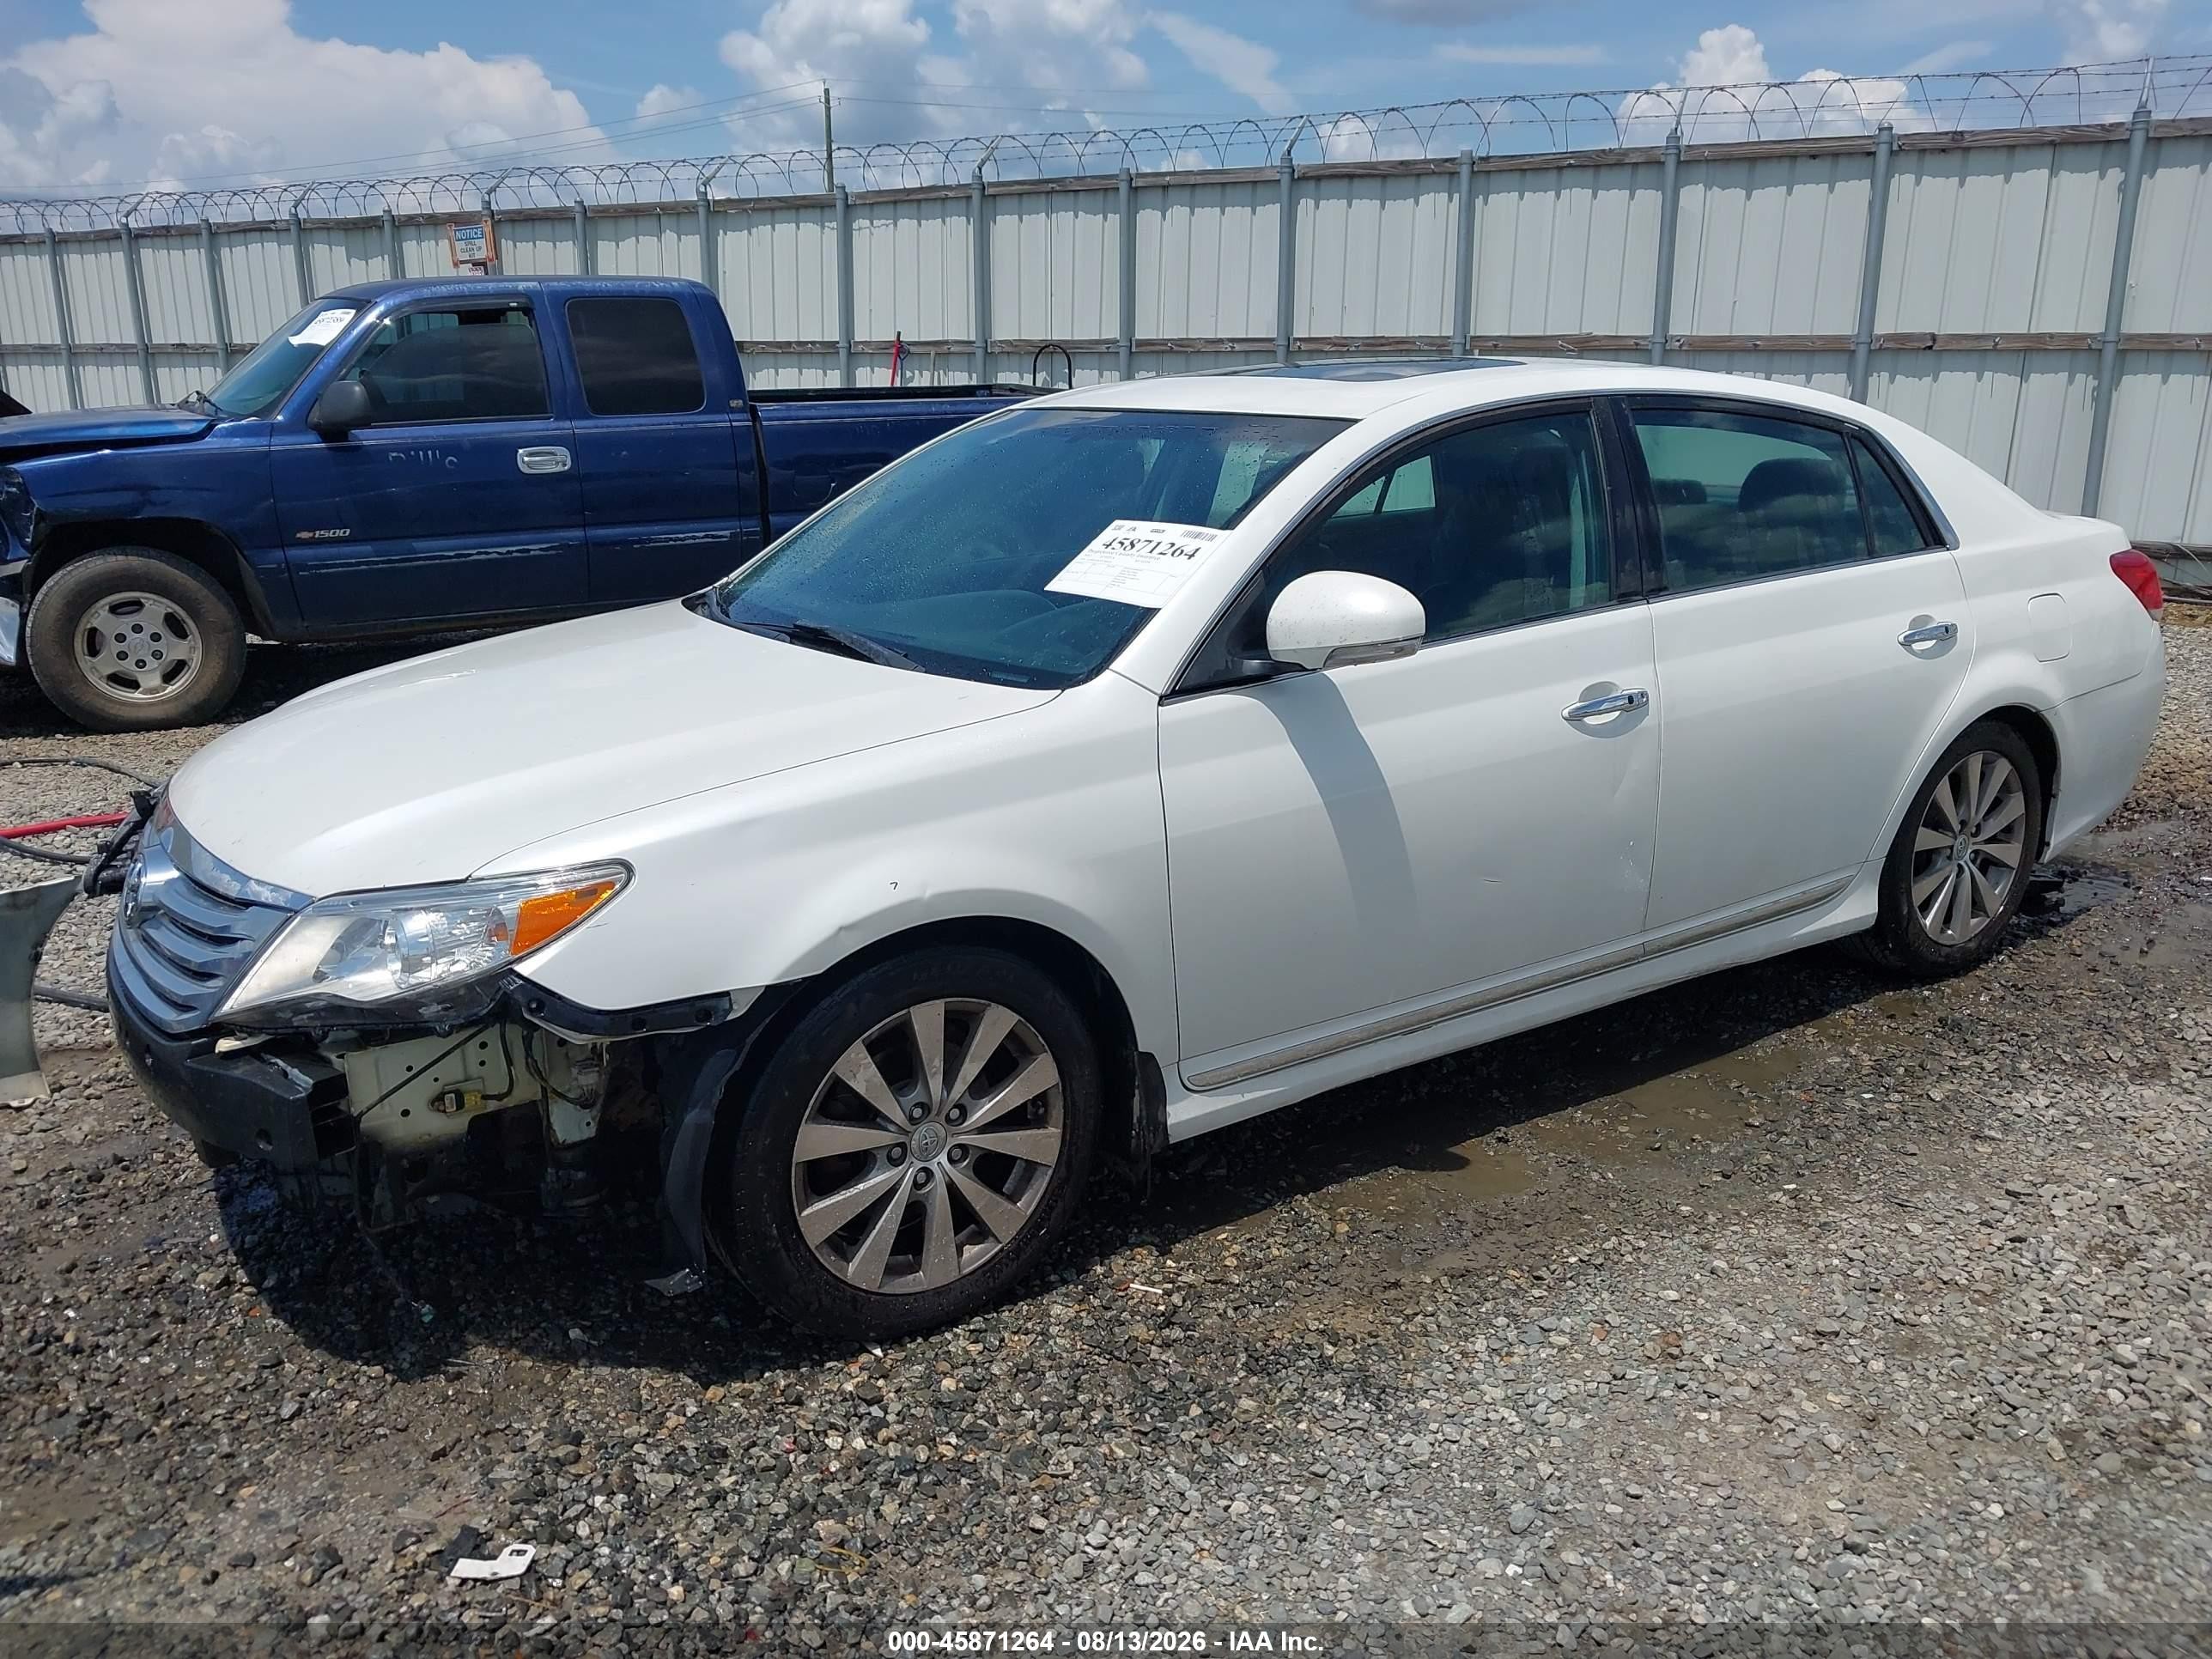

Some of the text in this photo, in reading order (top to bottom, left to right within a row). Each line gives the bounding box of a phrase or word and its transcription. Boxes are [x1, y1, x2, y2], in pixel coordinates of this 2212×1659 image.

[456, 228, 483, 240] NOTICE
[315, 528, 350, 538] 1500
[1103, 536, 1202, 561] 45871264
